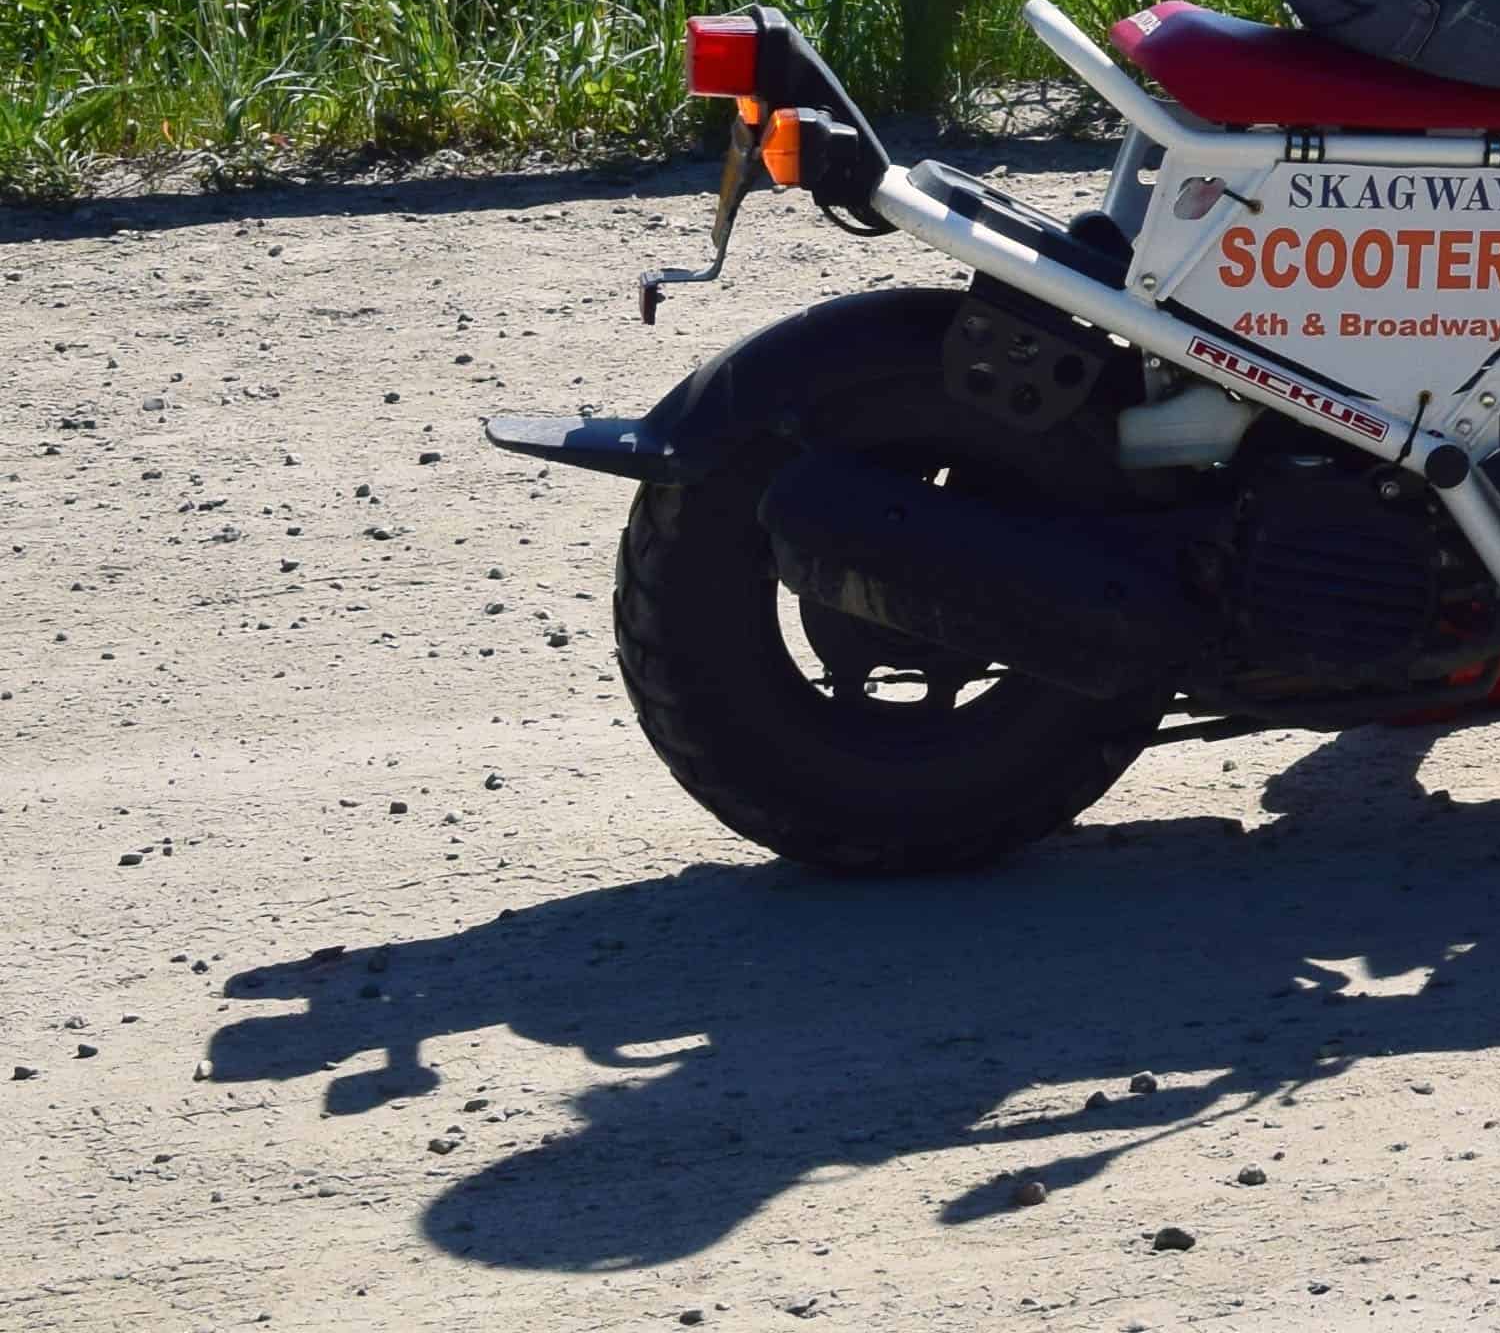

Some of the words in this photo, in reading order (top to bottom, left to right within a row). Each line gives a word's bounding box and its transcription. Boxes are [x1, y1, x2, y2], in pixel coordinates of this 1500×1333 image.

[1233, 312, 1289, 337] 4th
[1302, 313, 1326, 337] &
[1192, 341, 1387, 438] RUCKUS
